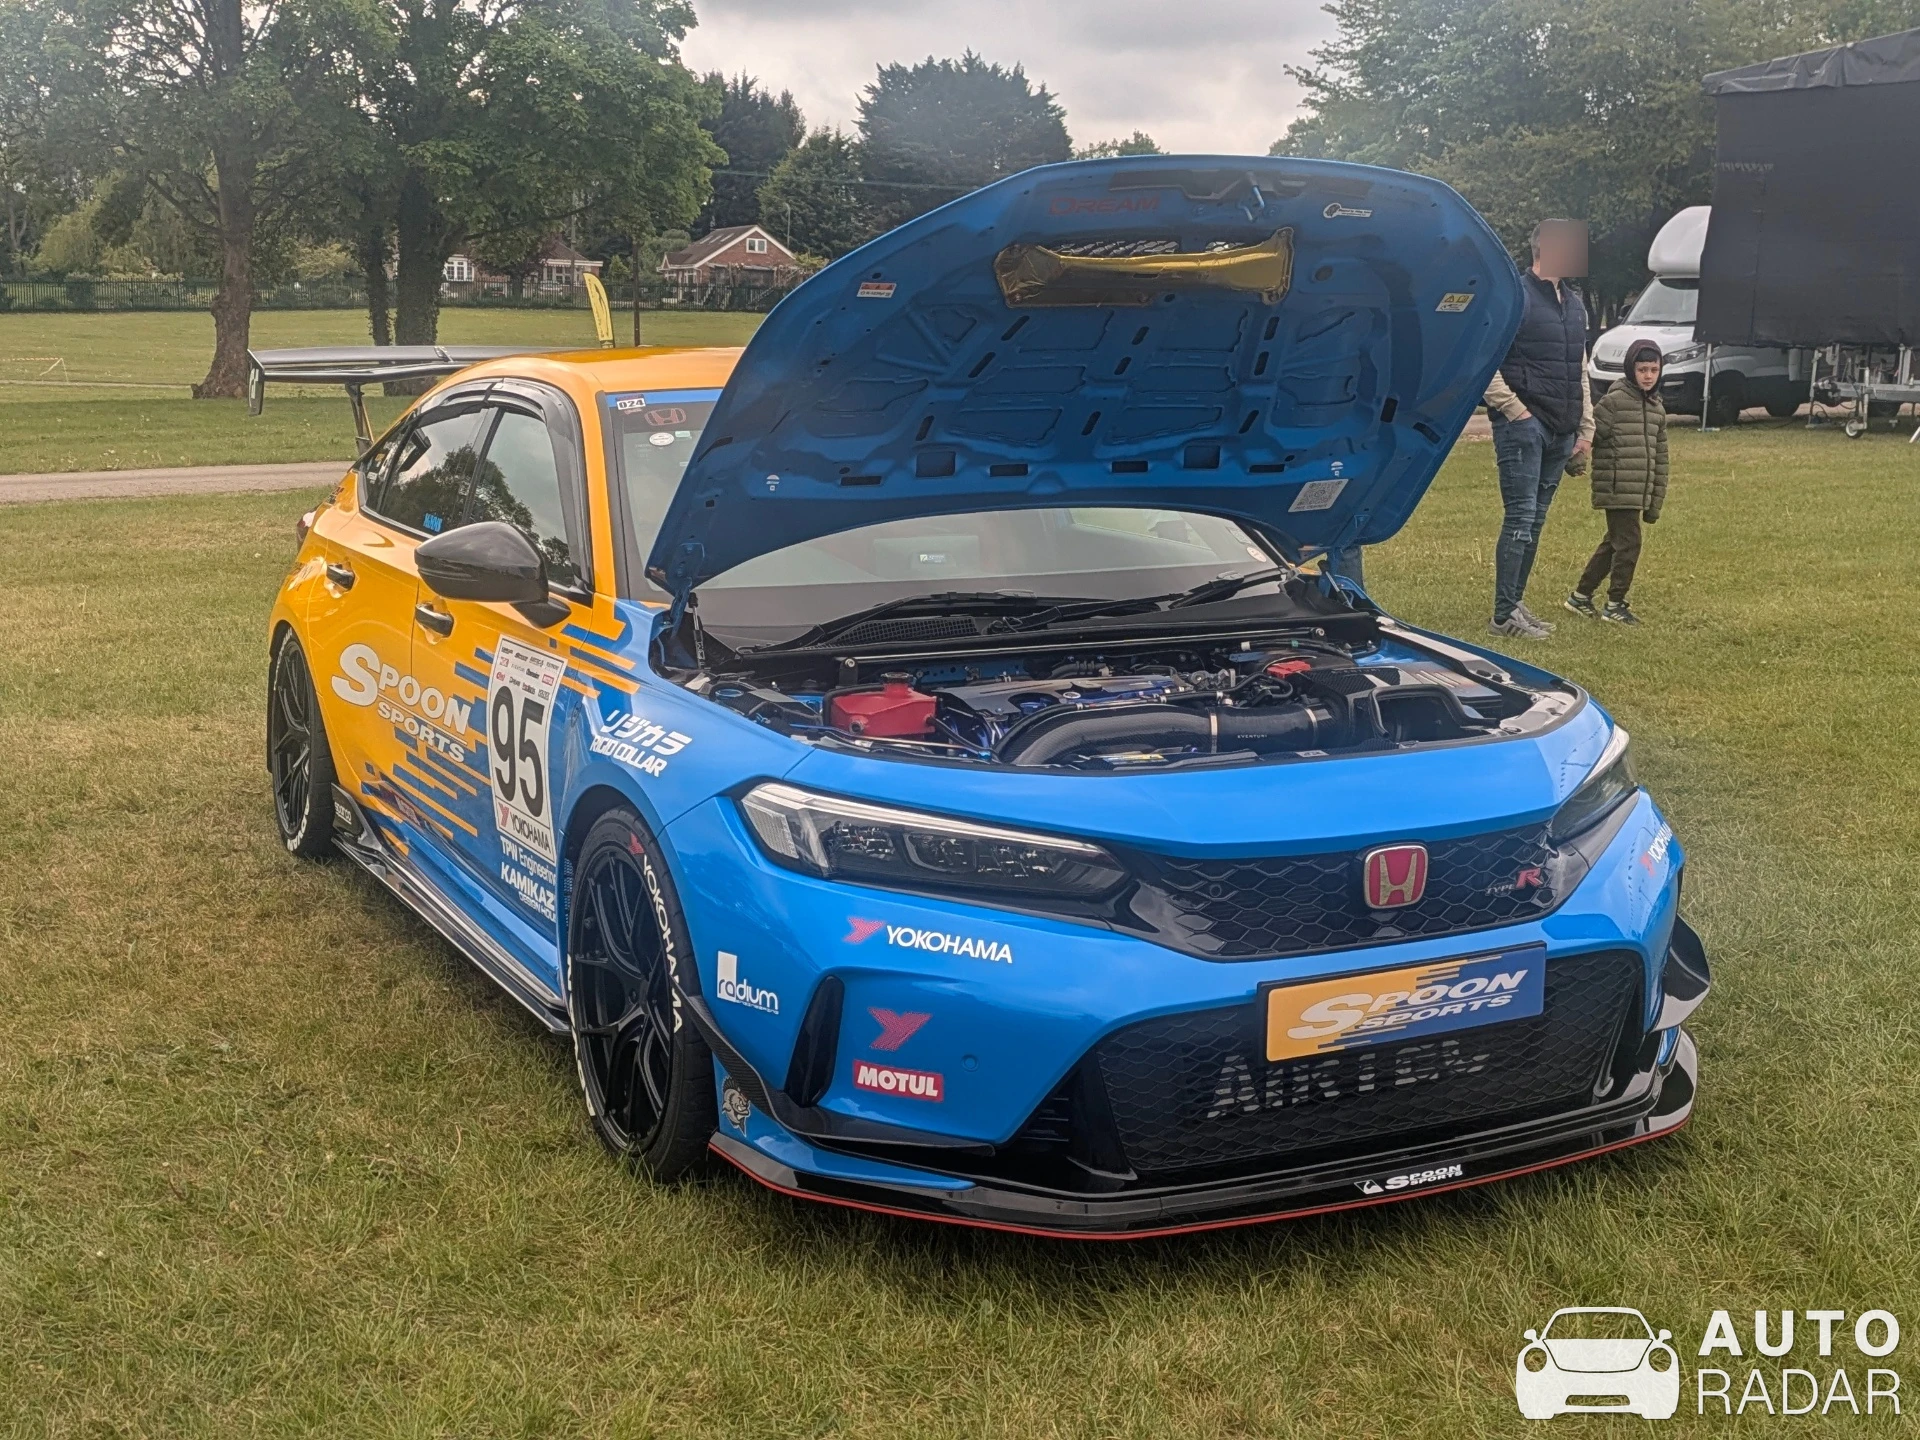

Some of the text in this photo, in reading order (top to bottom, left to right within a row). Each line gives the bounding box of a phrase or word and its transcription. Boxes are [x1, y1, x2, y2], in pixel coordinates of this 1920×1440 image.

[1048, 195, 1160, 215] DREAM
[618, 399, 644, 409] 024
[331, 643, 472, 736] SPOON
[377, 702, 465, 764] SPORTS
[600, 709, 693, 756] リジカラ
[492, 685, 546, 818] 95
[334, 801, 352, 822] sparco
[500, 834, 518, 862] TPW
[510, 812, 551, 854] YOKOHAMA
[1648, 821, 1674, 864] YOKOHAM
[1485, 867, 1543, 896] TYPE R
[886, 925, 1013, 964] YOKOHAMA
[718, 978, 779, 1010] radium
[1287, 970, 1528, 1040] SPOON
[1355, 994, 1512, 1030] SPORTS
[857, 1065, 939, 1097] MOTUL
[1385, 1164, 1462, 1190] SPOON
[1410, 1170, 1463, 1186] SPORTS
